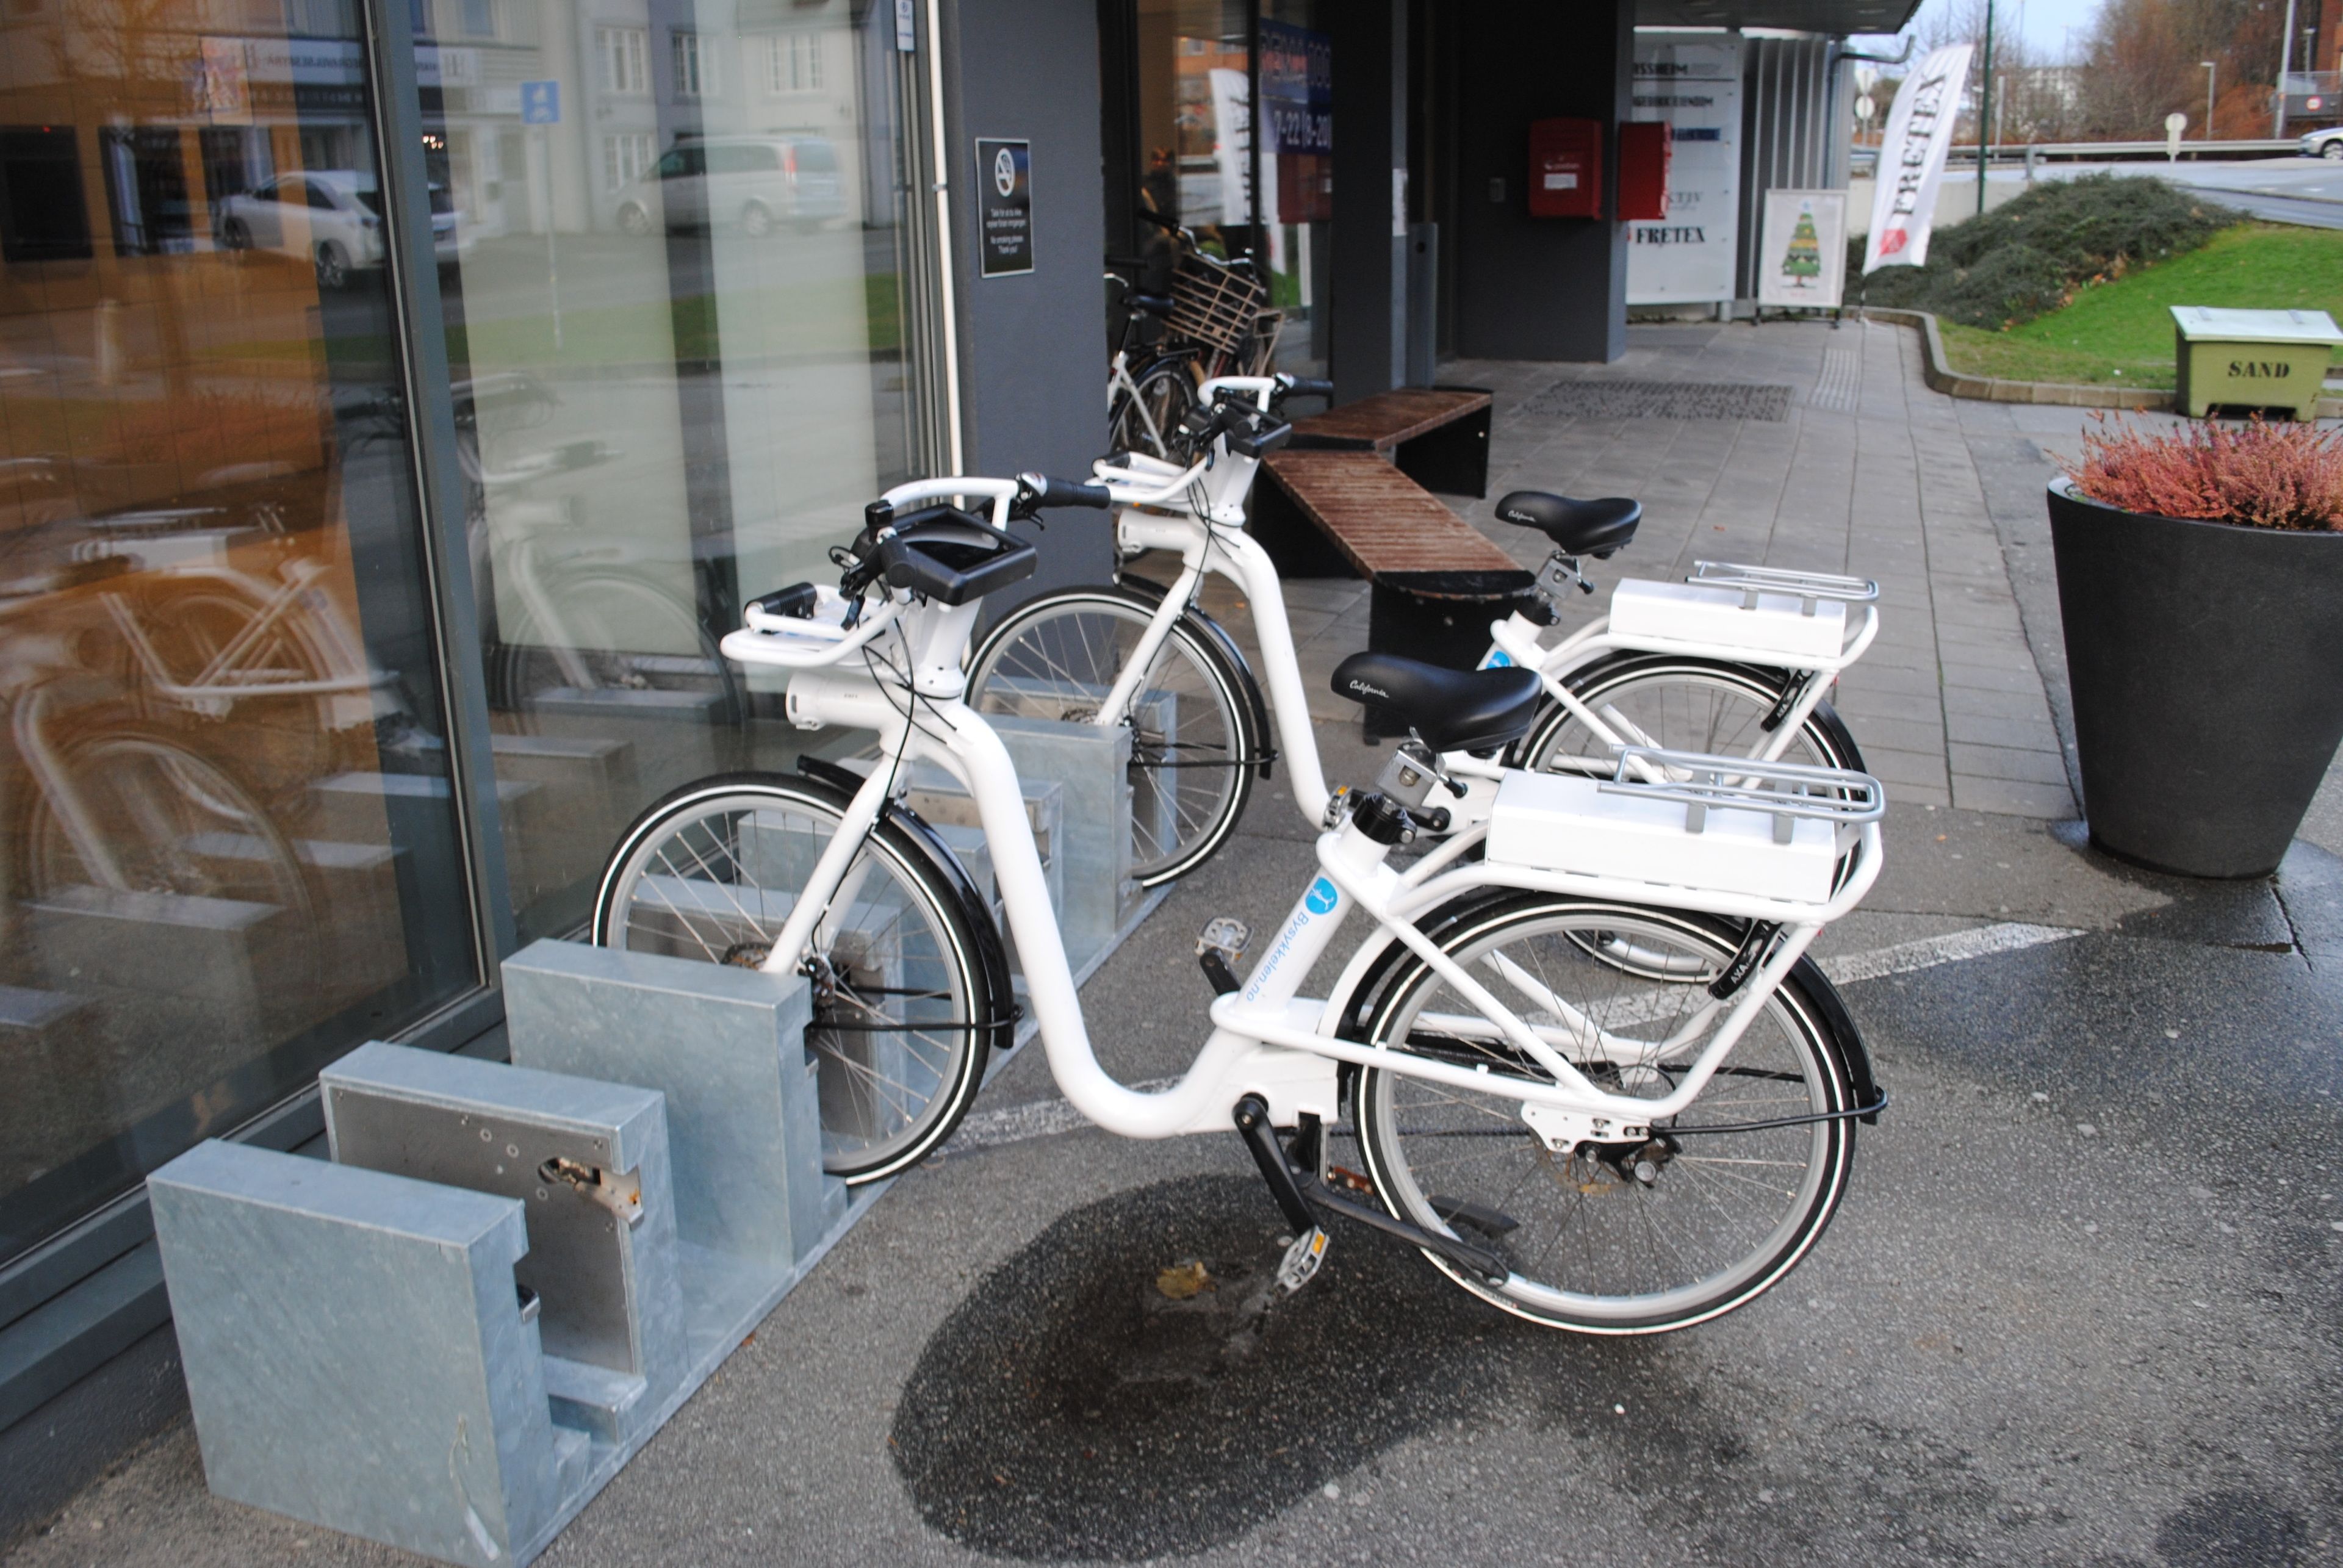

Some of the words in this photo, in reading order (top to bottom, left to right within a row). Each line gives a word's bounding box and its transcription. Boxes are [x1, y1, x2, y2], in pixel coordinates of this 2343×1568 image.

[1892, 74, 1946, 215] FRETEX
[1636, 226, 1705, 243] FRETEX
[2228, 361, 2289, 378] SAND
[1349, 679, 1389, 698] California
[1246, 911, 1309, 1002] Bysykkelen.no
[1730, 964, 1749, 984] AXA
